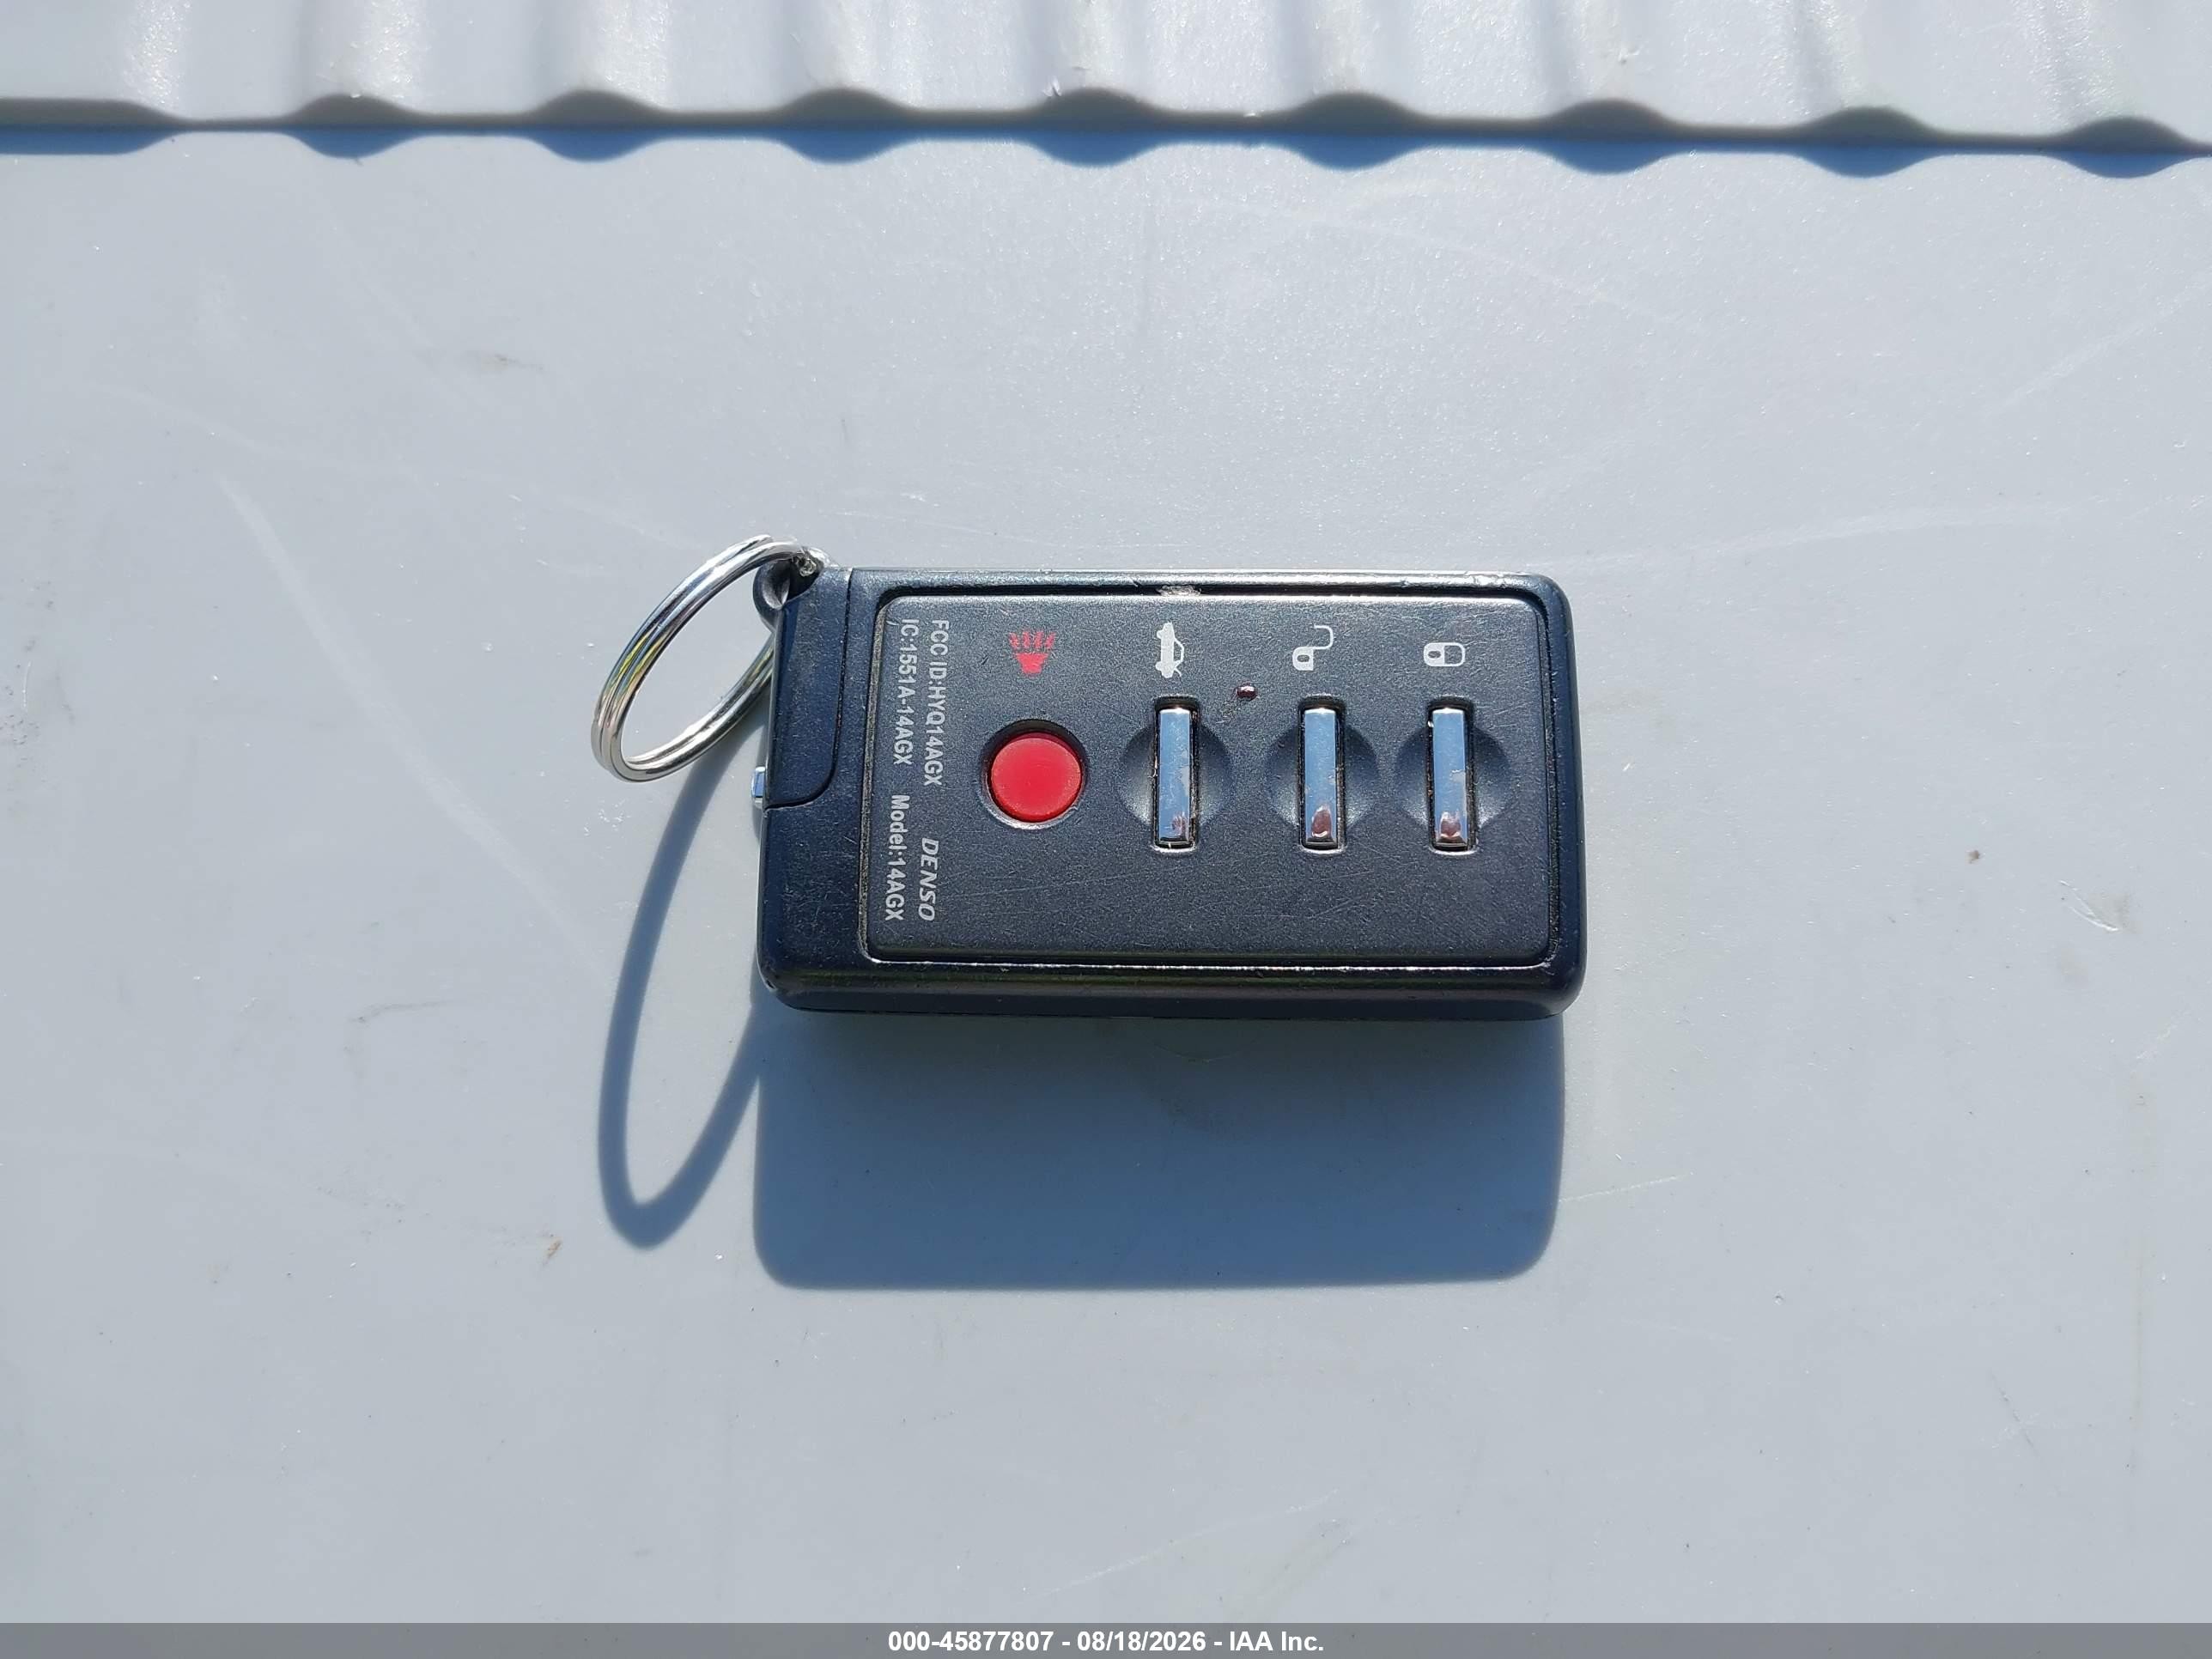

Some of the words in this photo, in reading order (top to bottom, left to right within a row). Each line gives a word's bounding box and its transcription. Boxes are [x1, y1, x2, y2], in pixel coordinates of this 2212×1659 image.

[893, 618, 920, 766] IC:1551A-14AGX
[930, 619, 950, 656] FCC
[924, 661, 948, 787] ID:HYQ14AGX
[884, 794, 910, 921] Model:14AGX
[918, 837, 939, 921] DENSO
